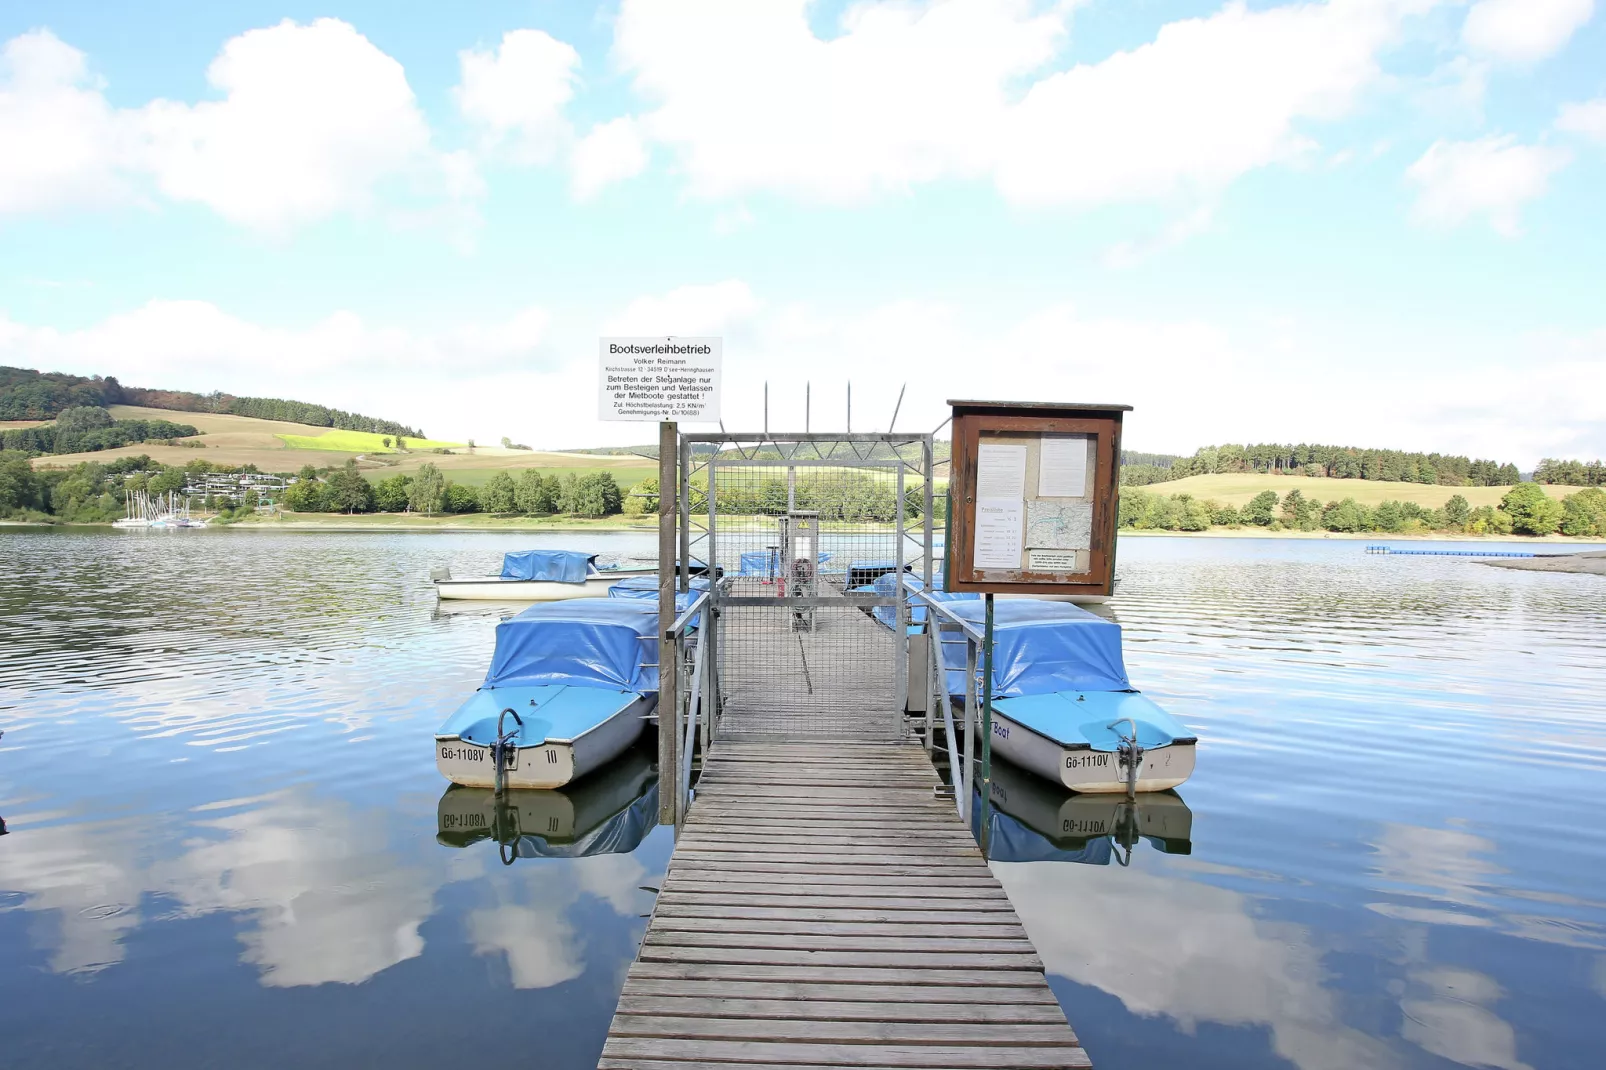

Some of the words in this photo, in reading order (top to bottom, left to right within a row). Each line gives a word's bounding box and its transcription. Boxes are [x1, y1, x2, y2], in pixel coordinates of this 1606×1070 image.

[609, 344, 711, 354] Bootsverleihbetrieb
[607, 375, 638, 383] Betreten
[640, 375, 653, 383] der
[655, 375, 697, 384] Steganlage
[623, 383, 660, 392] Besteigen
[678, 384, 713, 392] Verlassen
[666, 392, 700, 401] gestattet
[625, 401, 674, 409] Höchstbelastung:
[994, 721, 1010, 740] Boat
[441, 747, 485, 762] Gö-1108V
[545, 749, 558, 764] 10
[1065, 754, 1109, 768] Gö-1110V
